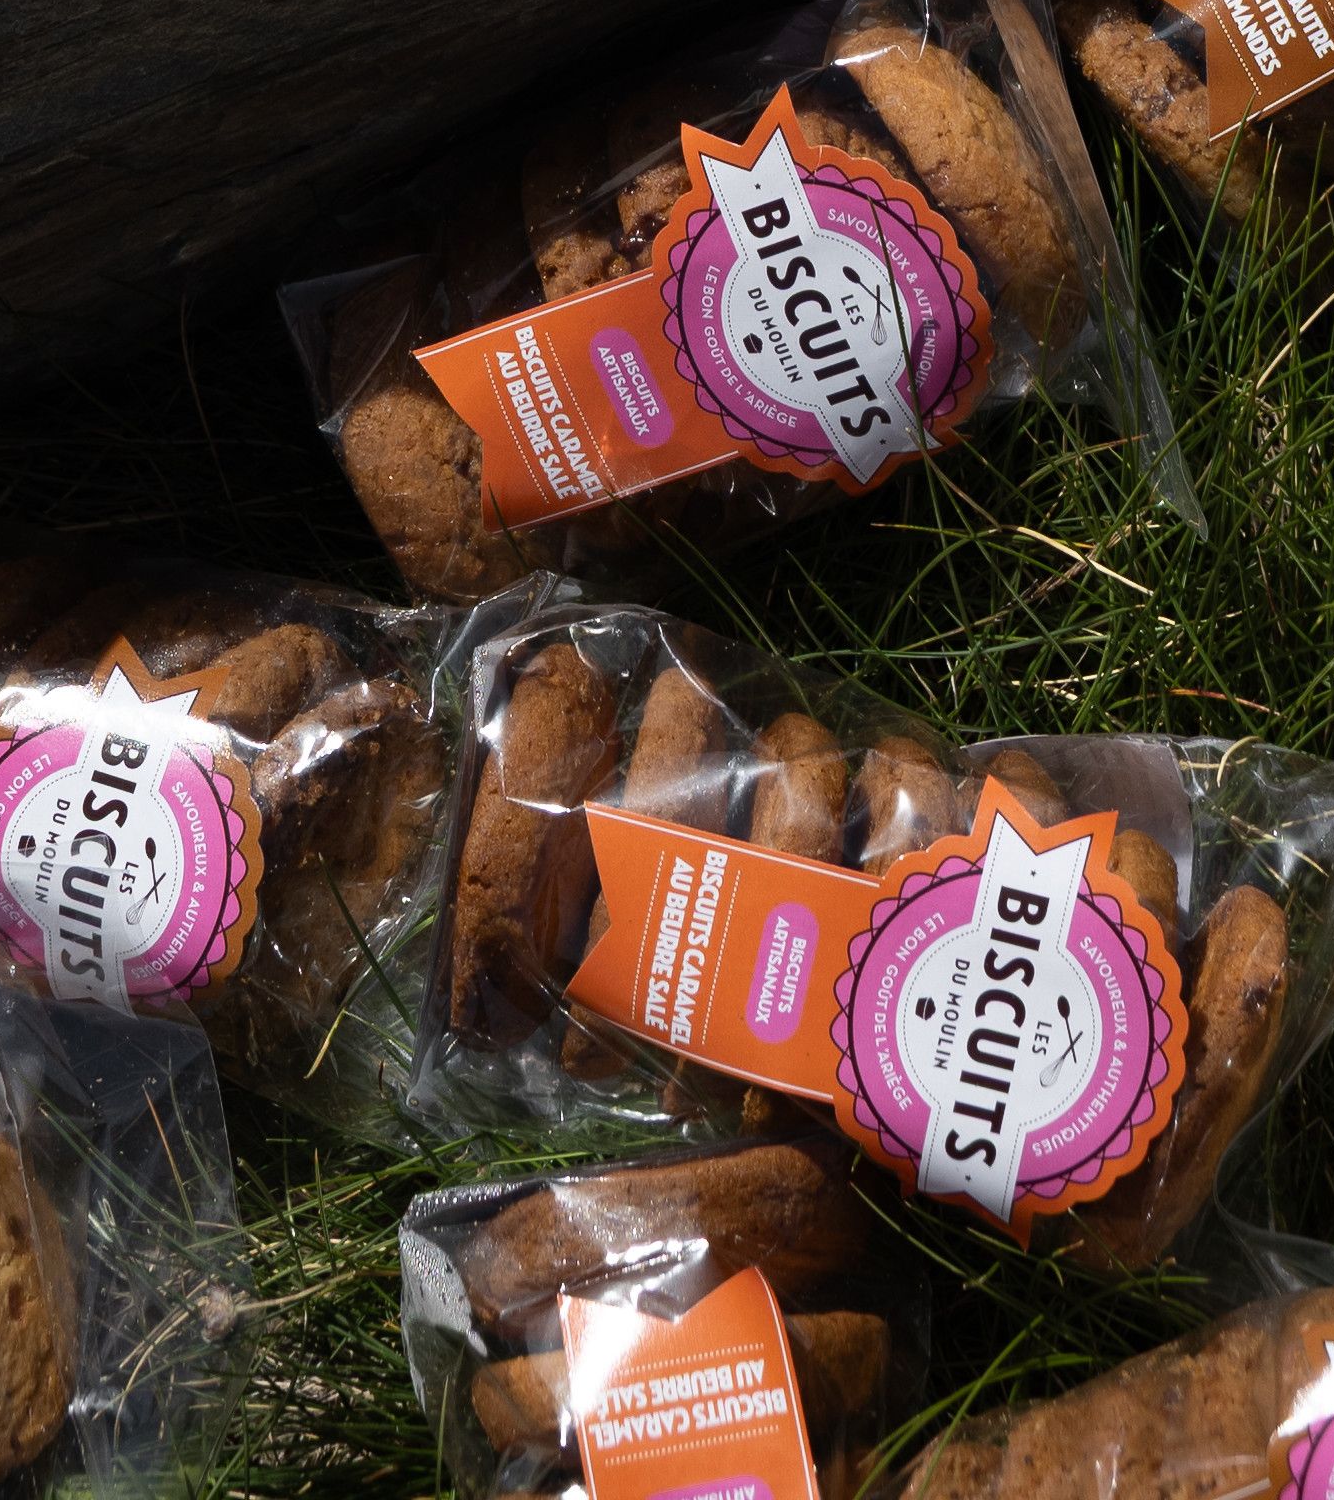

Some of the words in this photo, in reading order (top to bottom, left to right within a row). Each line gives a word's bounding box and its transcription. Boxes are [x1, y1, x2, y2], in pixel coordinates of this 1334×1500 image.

[827, 208, 911, 272] SAVOUREUX
[905, 272, 918, 284] &
[707, 264, 722, 284] LE
[701, 285, 716, 320] BON
[741, 196, 891, 438] BISCUITS
[840, 294, 865, 326] LES
[748, 287, 769, 314] DU
[761, 320, 804, 384] MOULIN
[495, 351, 521, 379] AU
[620, 352, 659, 417] BISCUITS
[721, 365, 740, 387] DE
[515, 325, 563, 414] BISCUITS
[550, 414, 605, 499] CARAMEL
[598, 346, 650, 436] ARTISANAUX
[506, 379, 554, 456] BEURRE
[539, 453, 578, 500] SALÉ
[4, 766, 33, 799] BON
[33, 753, 52, 772] LE
[52, 799, 71, 825] DU
[58, 732, 150, 983] BISCUITS
[171, 782, 207, 877] SAVOUREUX
[192, 881, 205, 893] &
[35, 832, 61, 904] MOULIN
[119, 861, 139, 896] LES
[670, 856, 695, 892] AU
[688, 849, 728, 948] BISCUITS
[925, 912, 946, 930] LE
[651, 891, 689, 979] BEURRE
[895, 924, 928, 961] BON
[754, 916, 790, 1025] ARTISANAUX
[778, 937, 807, 1014] BISCUITS
[873, 964, 900, 1012] GOÛT
[951, 957, 970, 986] DU
[1079, 936, 1128, 1035] SAVOUREUX
[644, 977, 670, 1032] SALÉ
[670, 949, 705, 1045] CARAMEL
[873, 1013, 886, 1035] DE
[933, 993, 963, 1070] MOULIN
[944, 885, 1050, 1167] BISCUITS
[1032, 1020, 1053, 1056] LES
[1114, 1039, 1128, 1052] &
[1031, 1057, 1124, 1157] AUTHENTIQUES
[649, 1367, 733, 1405] BEURRE
[736, 1359, 764, 1386] AU
[588, 1410, 690, 1450] CARAMEL
[692, 1388, 788, 1429] BISCUITS
